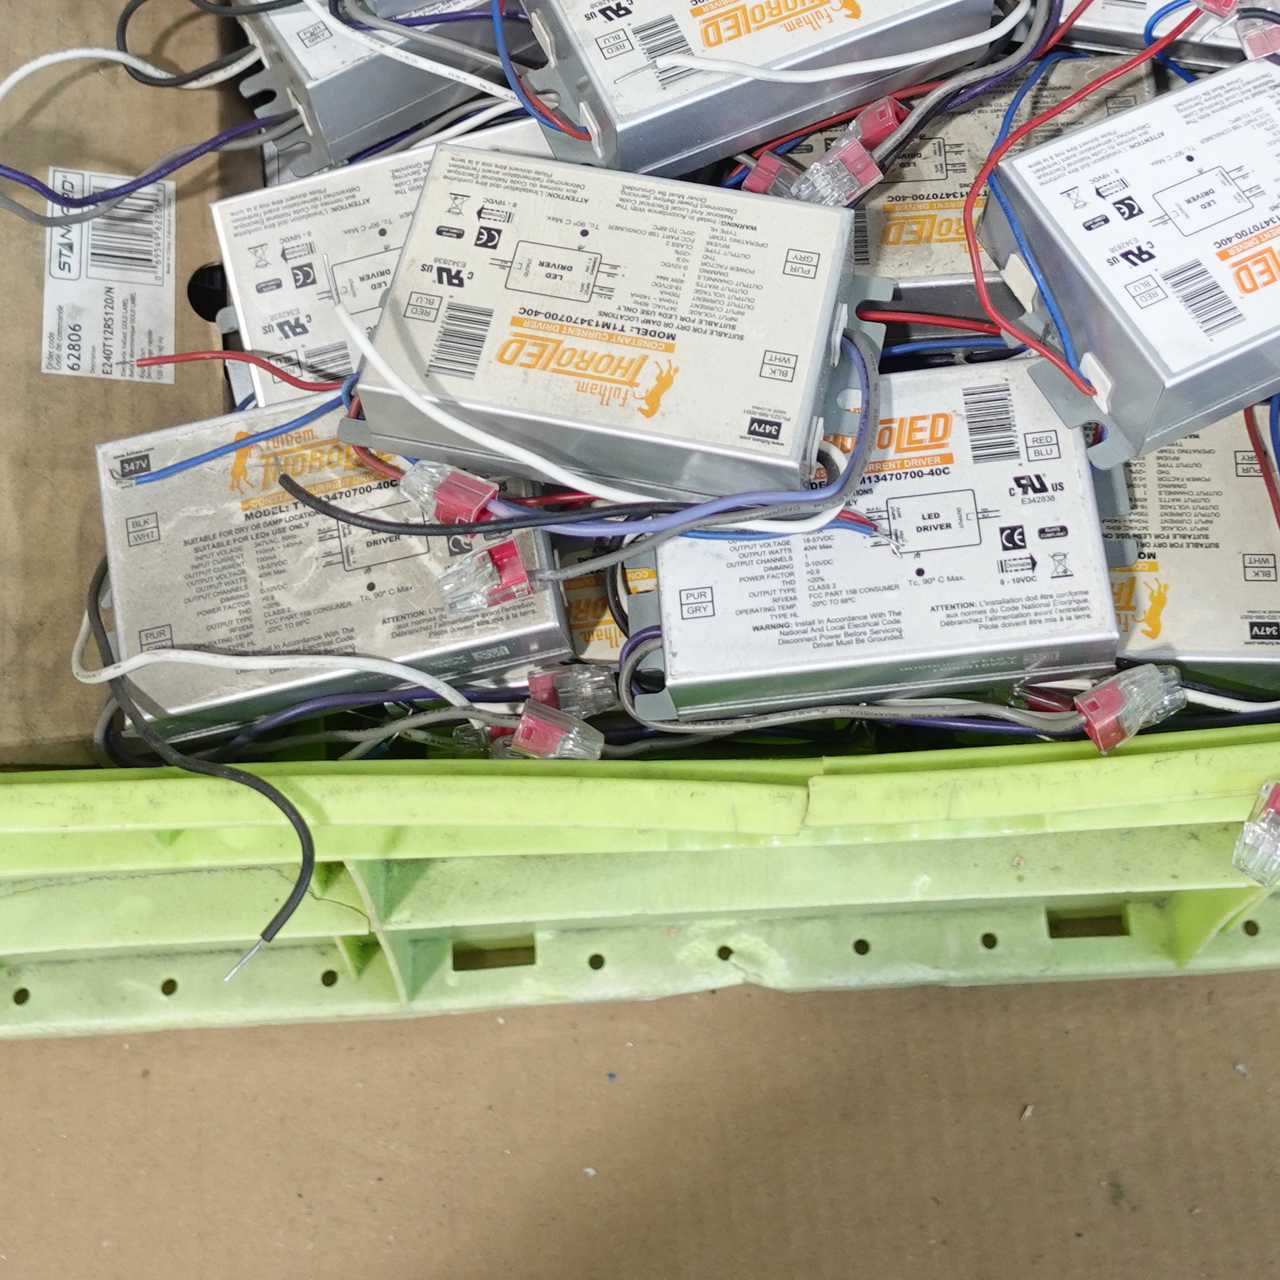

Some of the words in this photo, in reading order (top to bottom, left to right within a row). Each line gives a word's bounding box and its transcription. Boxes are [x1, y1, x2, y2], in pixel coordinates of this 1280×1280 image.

[601, 32, 621, 44] BLU
[605, 41, 626, 53] RED
[1183, 187, 1215, 204] DRIVER
[1198, 198, 1216, 209] LED
[1227, 236, 1260, 255] DRIVER
[791, 253, 813, 263] GRY
[537, 260, 573, 271] DRIVER
[788, 264, 810, 275] PUR
[358, 267, 390, 281] DRIVER
[544, 272, 563, 280] LED
[369, 279, 386, 289] LED
[1130, 279, 1151, 292] BLU
[414, 295, 435, 304] BLU
[1138, 289, 1159, 303] RED
[409, 306, 431, 316] RED
[522, 319, 559, 332] DRIVER
[560, 325, 609, 340] CURRENT
[628, 325, 676, 340] MODEL:
[66, 322, 82, 371] 62806
[611, 334, 665, 349] CONSTANT
[767, 353, 791, 364] WHT
[769, 367, 788, 377] BLK
[749, 421, 778, 434] 347V
[1031, 435, 1053, 445] RED
[1033, 448, 1054, 457] BLU
[123, 459, 148, 473] 347V
[903, 455, 940, 467] DRIVER
[921, 512, 940, 520] LED
[132, 518, 149, 529] BLK
[916, 522, 952, 533] DRIVER
[133, 530, 155, 542] WHT
[366, 534, 400, 548] DRIVER
[1252, 569, 1271, 577] BLK
[685, 590, 707, 601] PUR
[686, 604, 709, 615] GRY
[1251, 625, 1278, 634] 347V
